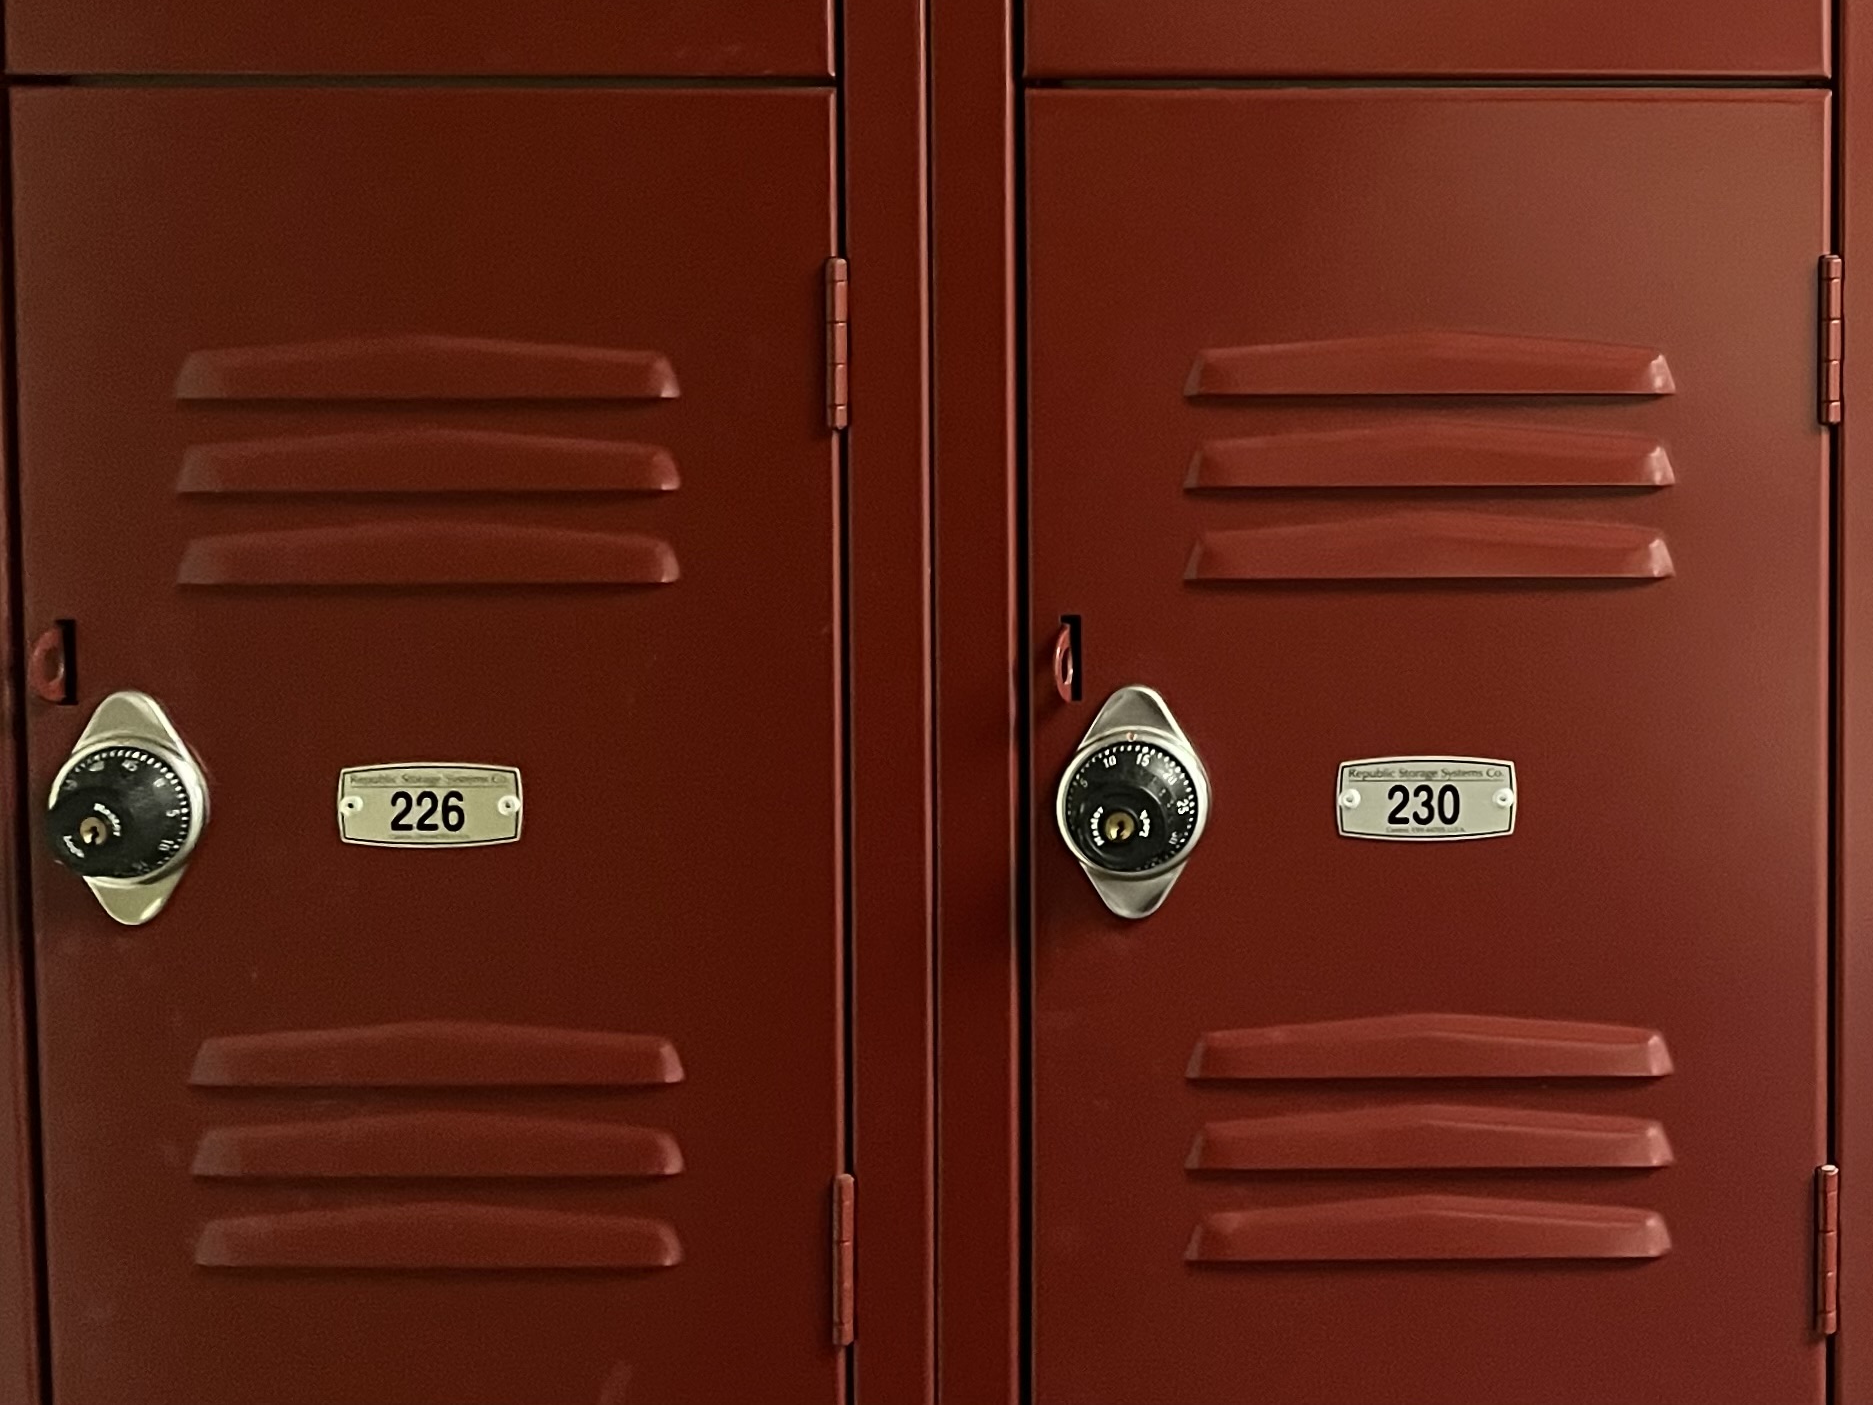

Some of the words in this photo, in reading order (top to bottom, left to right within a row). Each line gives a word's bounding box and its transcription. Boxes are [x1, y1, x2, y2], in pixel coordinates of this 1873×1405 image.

[1103, 754, 1117, 769] 10
[1135, 753, 1151, 767] 15
[1348, 768, 1396, 780] Republic
[1398, 768, 1438, 779] Storage
[1441, 768, 1483, 779] Systems
[1486, 768, 1504, 778] Co.
[389, 790, 466, 833] 226
[1176, 799, 1190, 815] 25
[1387, 784, 1461, 826] 230
